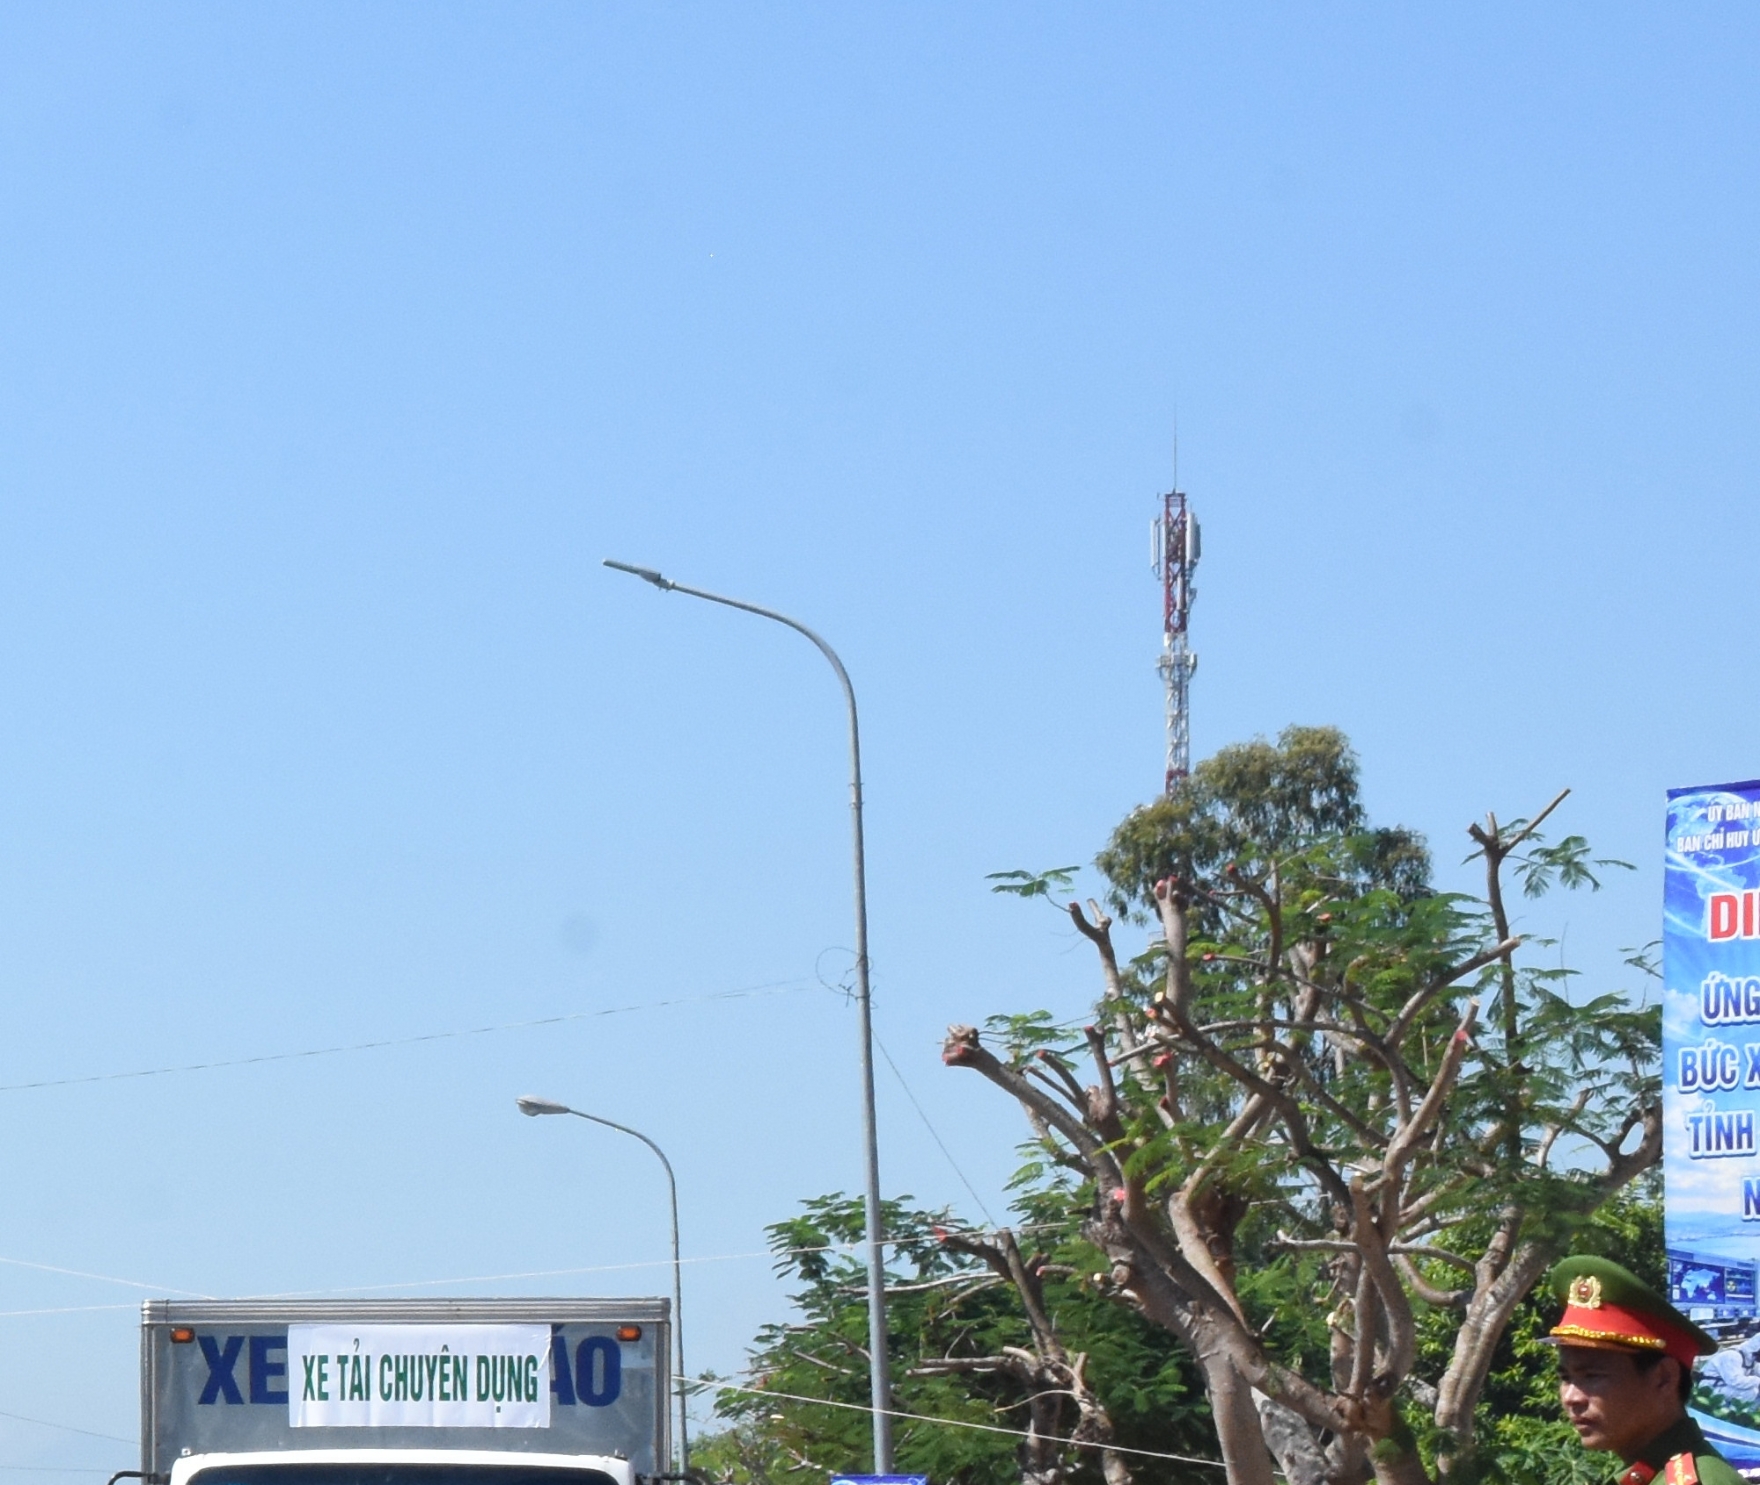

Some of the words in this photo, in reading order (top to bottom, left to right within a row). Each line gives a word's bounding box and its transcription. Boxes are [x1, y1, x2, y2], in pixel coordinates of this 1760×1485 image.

[1726, 803, 1750, 820] BAN
[1677, 835, 1700, 853] BAN
[1726, 830, 1749, 848] HUY
[1710, 893, 1760, 940] DI
[1702, 972, 1760, 1021] ỨNG
[1680, 1039, 1737, 1087] BỨC
[1689, 1101, 1754, 1152] TỈNH
[197, 1336, 289, 1404] XE
[302, 1355, 329, 1401] XE
[337, 1338, 370, 1401] TẢI
[380, 1344, 468, 1402] CHUYÊN
[476, 1355, 538, 1413] DỤNG
